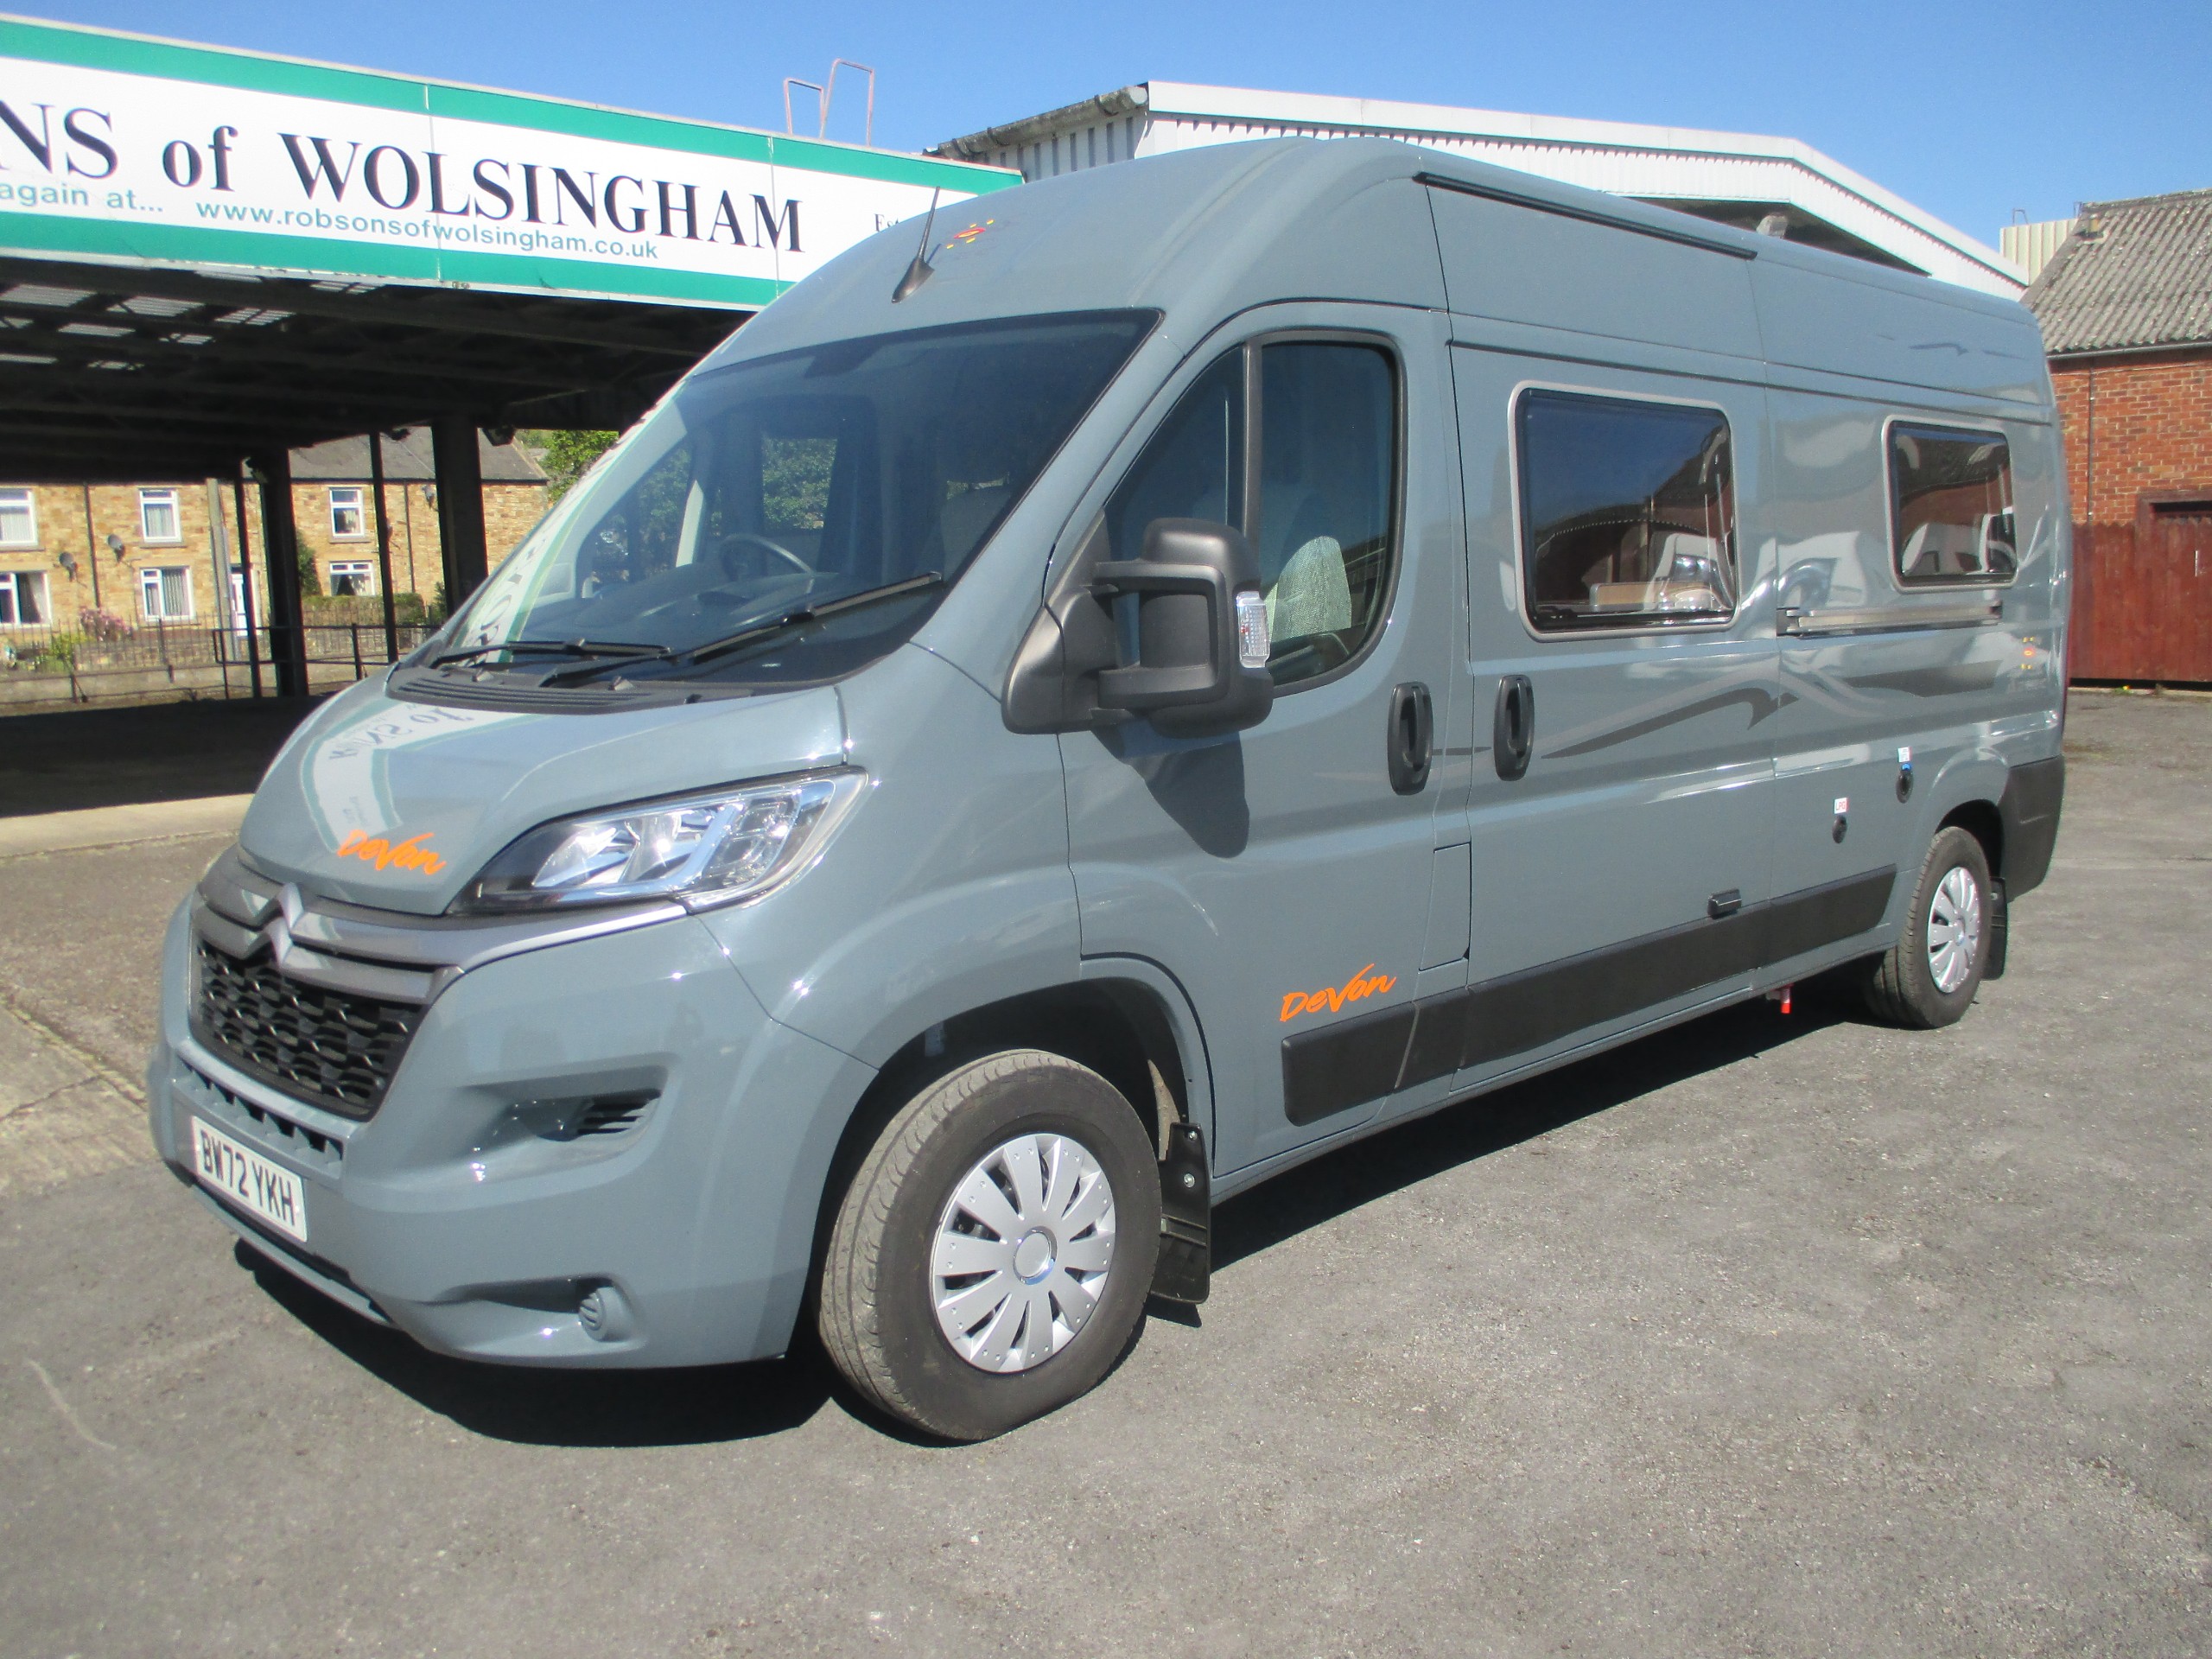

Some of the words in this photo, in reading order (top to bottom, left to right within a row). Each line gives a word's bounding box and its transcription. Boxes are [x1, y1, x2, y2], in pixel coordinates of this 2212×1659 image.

[0, 181, 89, 207] again
[196, 201, 658, 259] www.robsonsofwolsingham.co.uk
[162, 125, 238, 192] of
[276, 132, 805, 253] WOLSINGHAM
[251, 1160, 296, 1226] YKH
